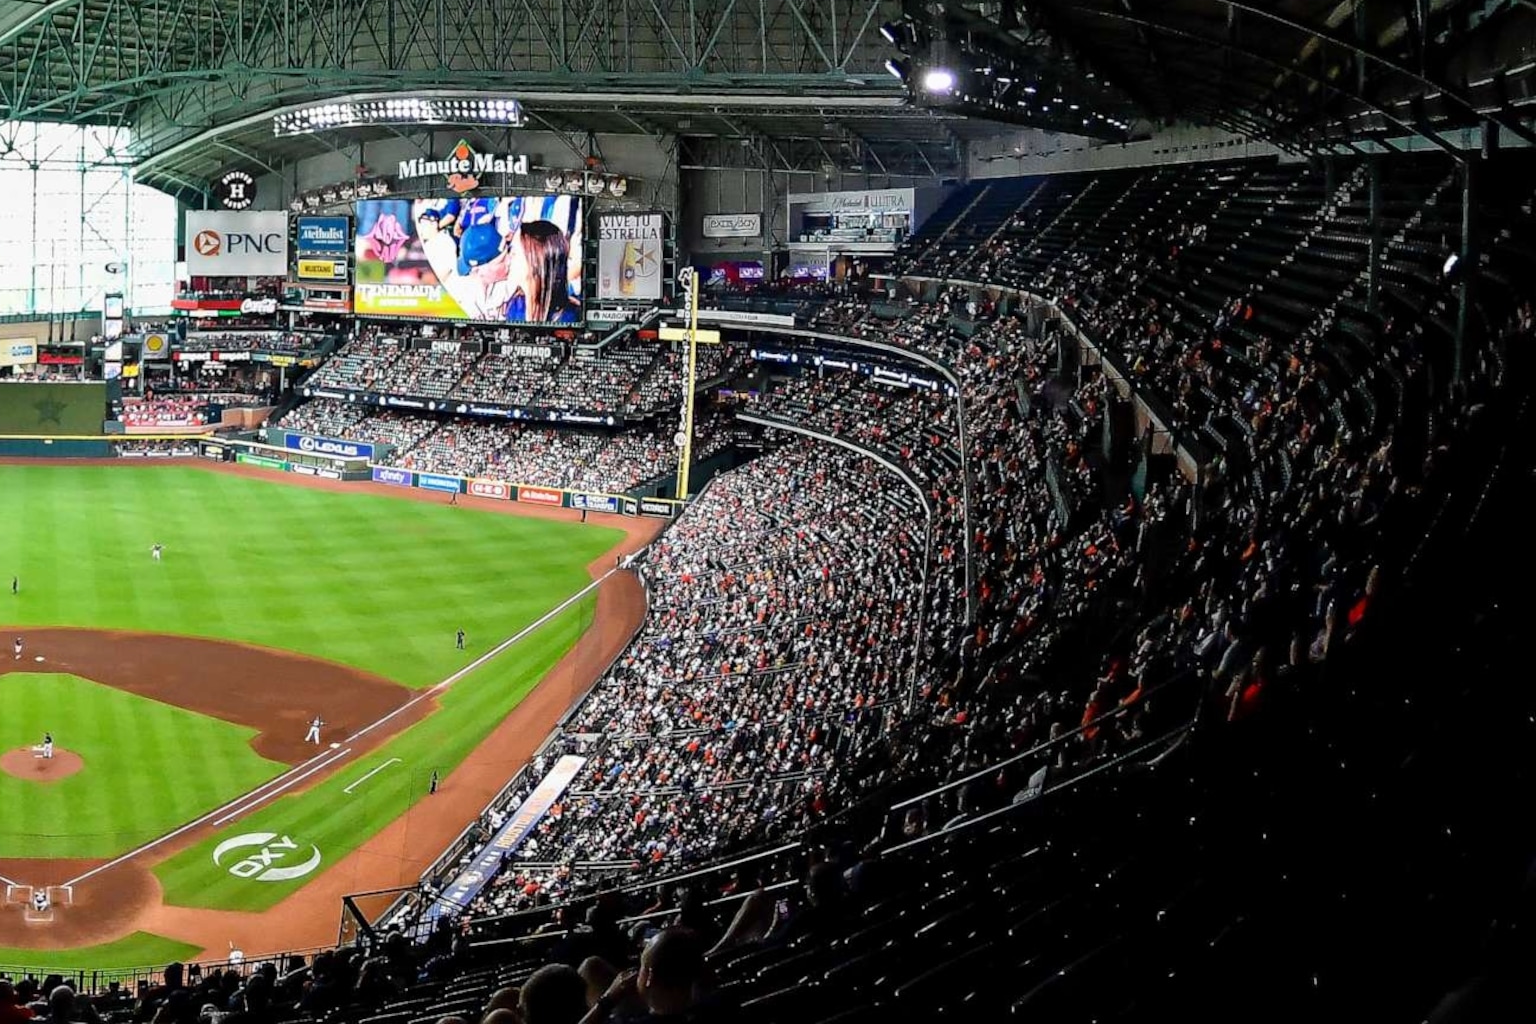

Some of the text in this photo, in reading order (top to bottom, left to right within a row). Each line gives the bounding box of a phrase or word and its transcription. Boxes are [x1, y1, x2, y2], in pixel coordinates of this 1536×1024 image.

[398, 153, 529, 179] Minute Maid
[230, 183, 245, 199] H
[870, 195, 905, 207] ULTRA
[600, 214, 651, 227] VIVE TU
[735, 216, 757, 230] Bay
[301, 228, 344, 240] Methodist
[599, 227, 658, 241] ESTRELLA
[224, 233, 282, 254] PNC
[304, 264, 331, 273] MUSTANG
[431, 340, 462, 354] CHEVY
[314, 441, 358, 456] LEXUS
[379, 470, 405, 484] xfinity
[427, 477, 459, 489] HONDA
[474, 483, 504, 495] H-E-B
[228, 835, 297, 876] OXY
